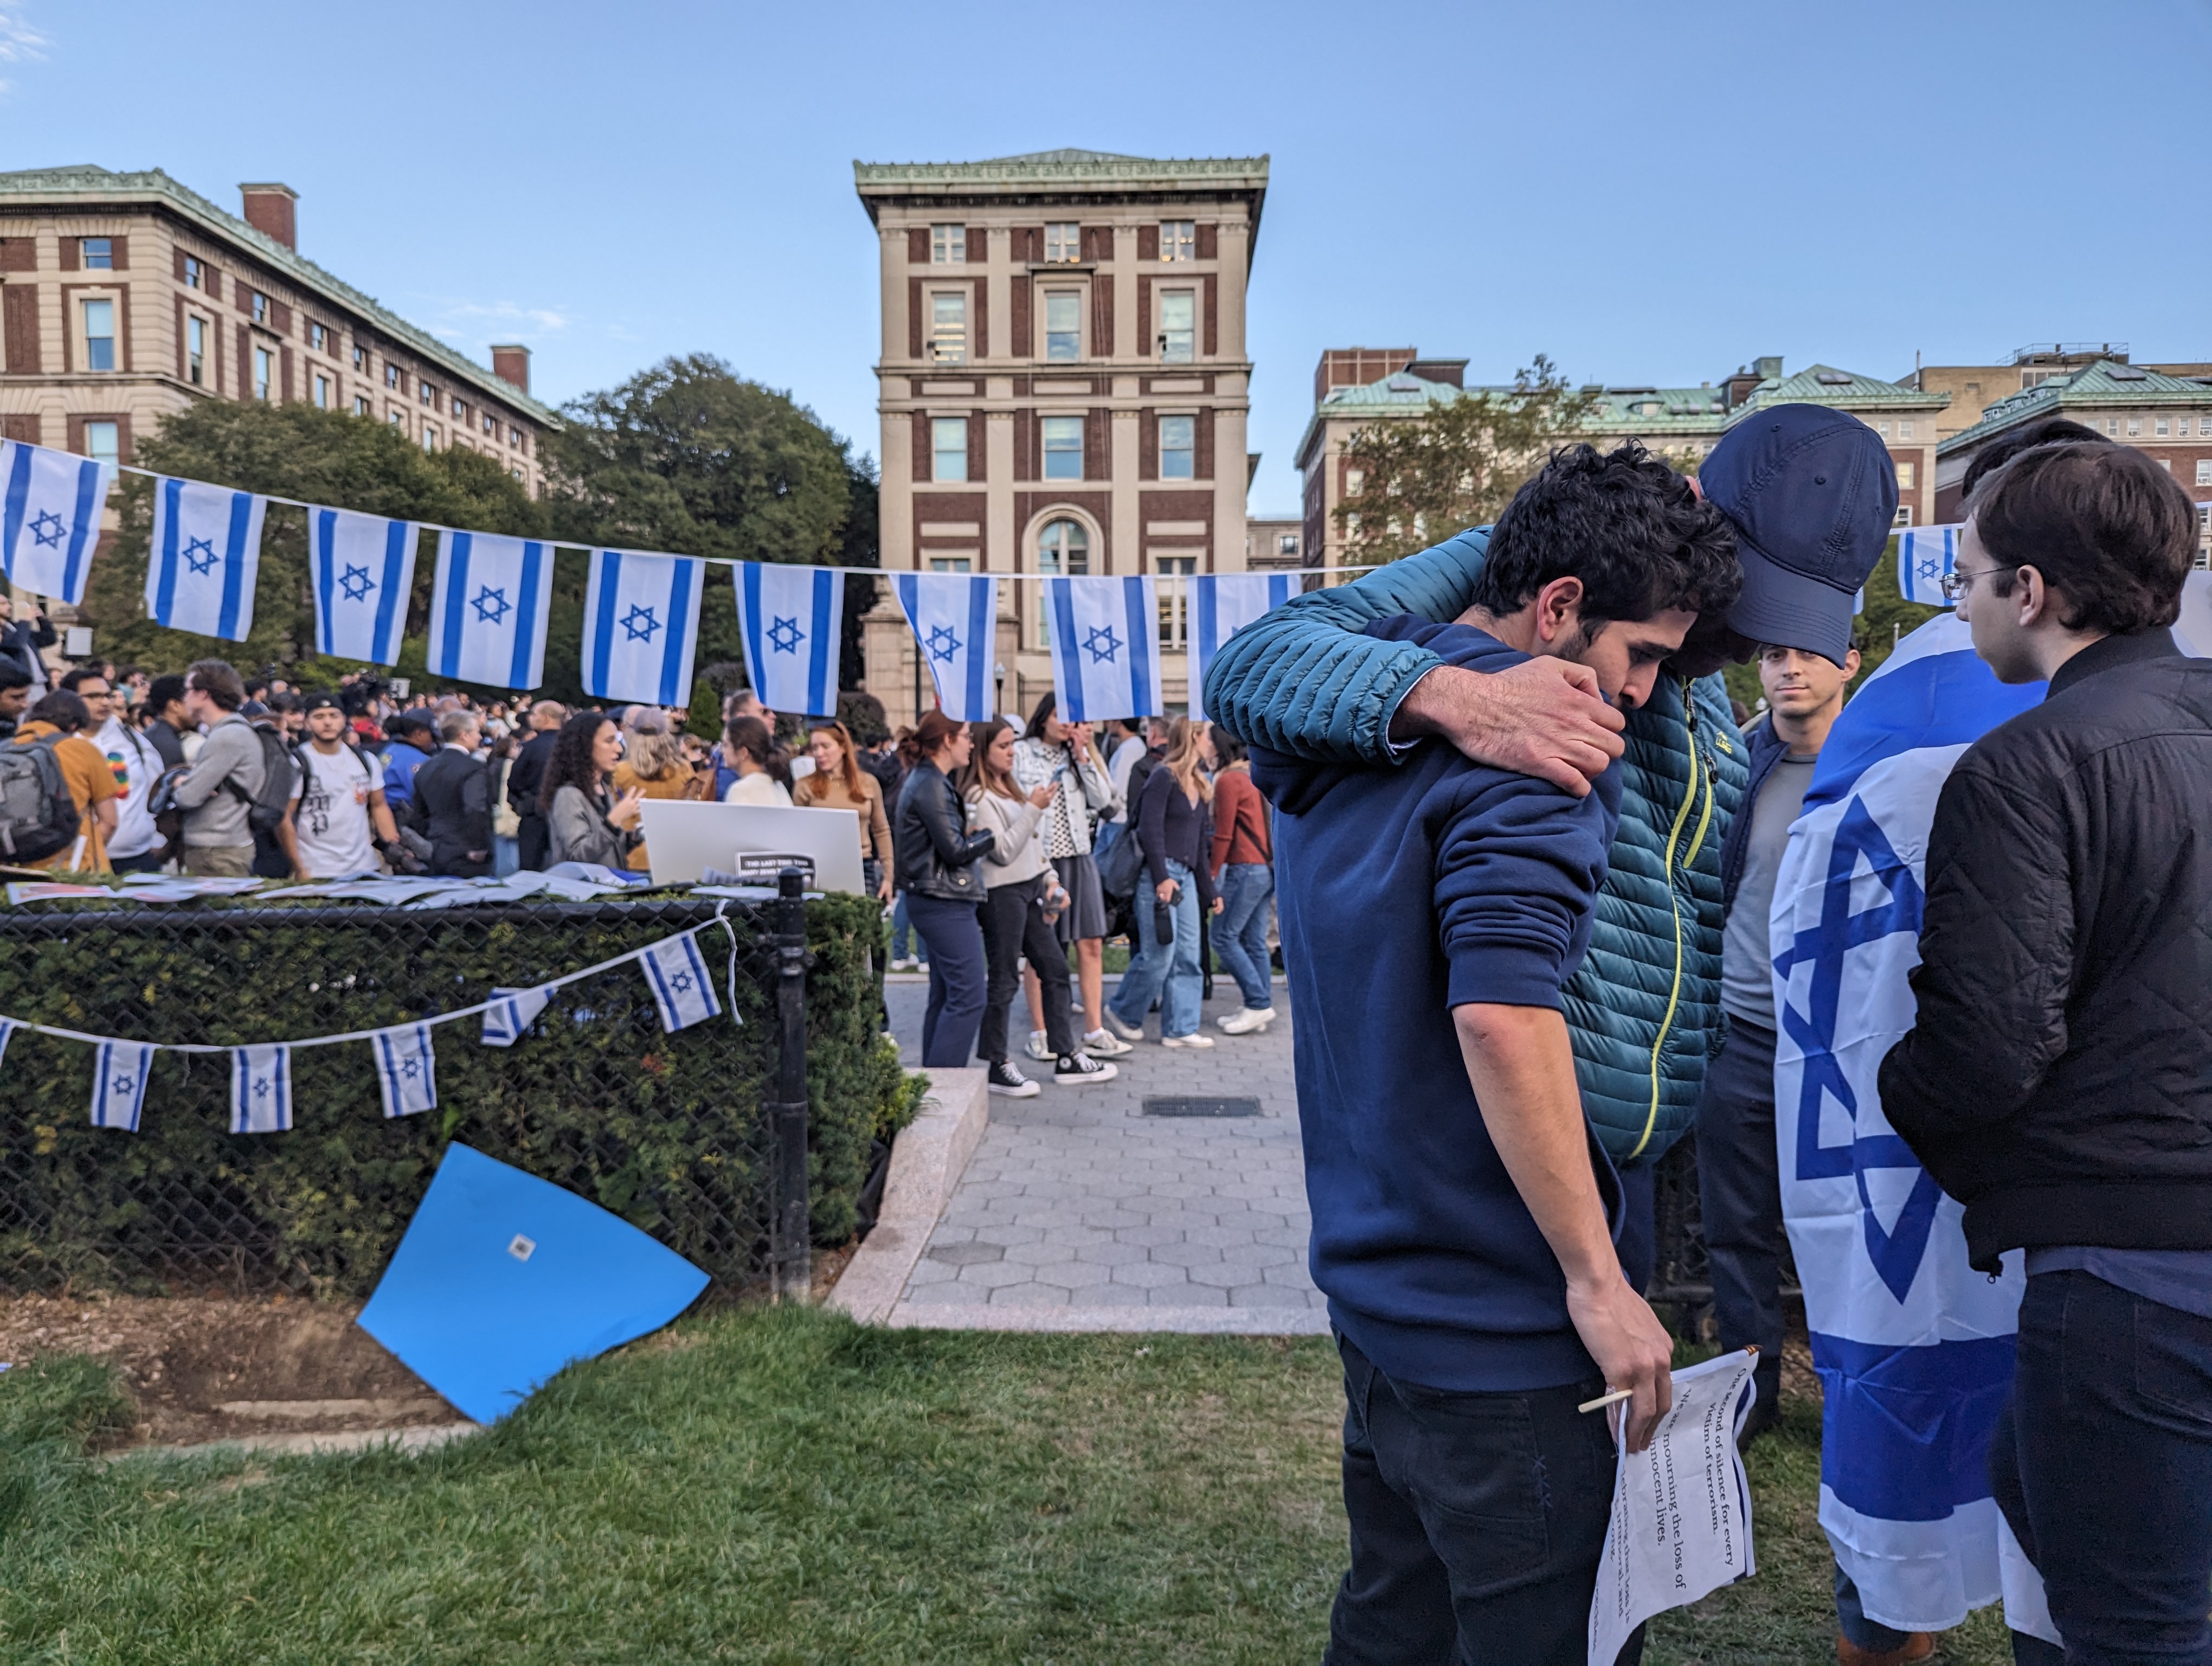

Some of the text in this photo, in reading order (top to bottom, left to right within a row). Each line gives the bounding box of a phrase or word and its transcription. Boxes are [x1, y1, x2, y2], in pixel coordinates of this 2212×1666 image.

[1621, 1464, 1630, 1543] lebrating
[1649, 1436, 1667, 1546] innocent lives.
[1663, 1388, 1692, 1589] We are mourning the loss of
[1704, 1402, 1719, 1535] victim of terrorism.
[1715, 1368, 1746, 1566] One second of silence for every
[1625, 1609, 1631, 1624] is
